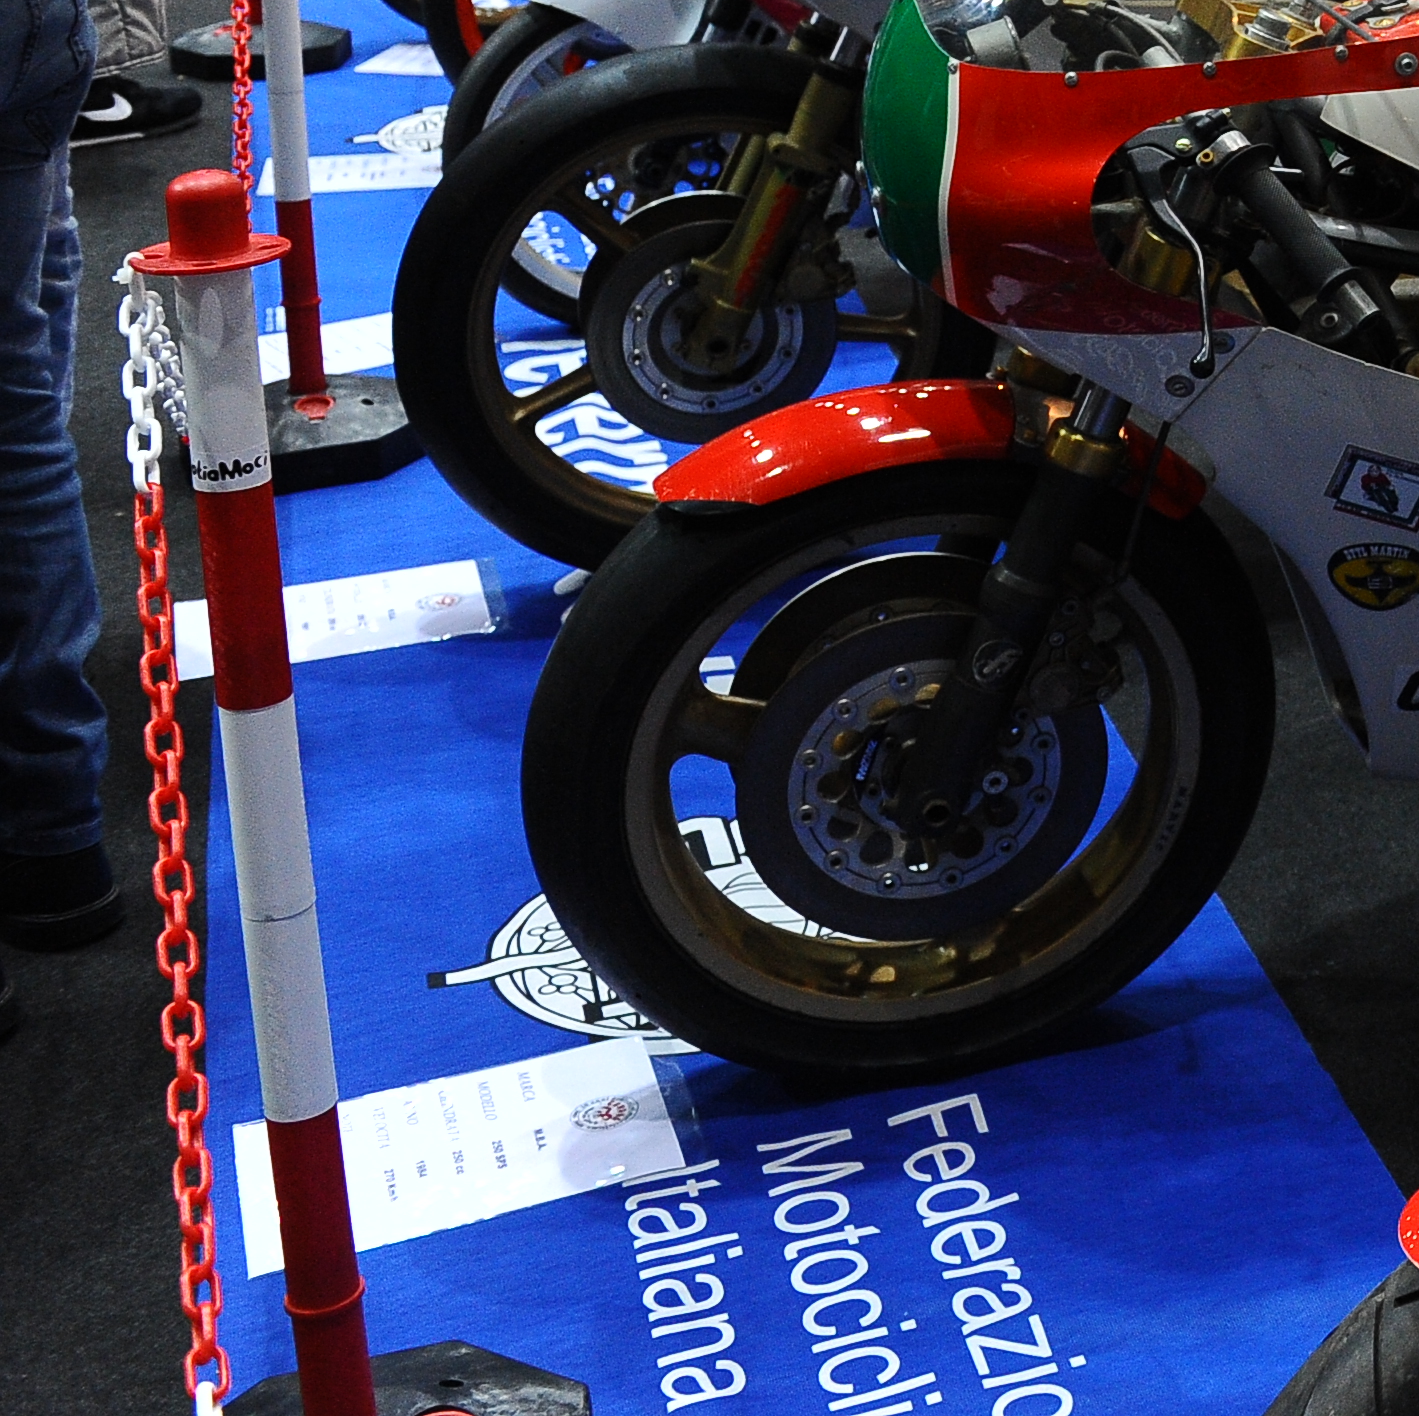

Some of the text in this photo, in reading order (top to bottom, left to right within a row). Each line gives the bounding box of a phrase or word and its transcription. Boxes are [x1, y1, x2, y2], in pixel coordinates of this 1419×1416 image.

[517, 1072, 536, 1103] MARCA
[477, 1081, 497, 1121] MODELLO
[492, 1140, 504, 1154] 250
[452, 1150, 465, 1164] 250
[456, 1165, 465, 1175] cc
[887, 1092, 1087, 1416] Federazio
[622, 1158, 747, 1413] Italiana
